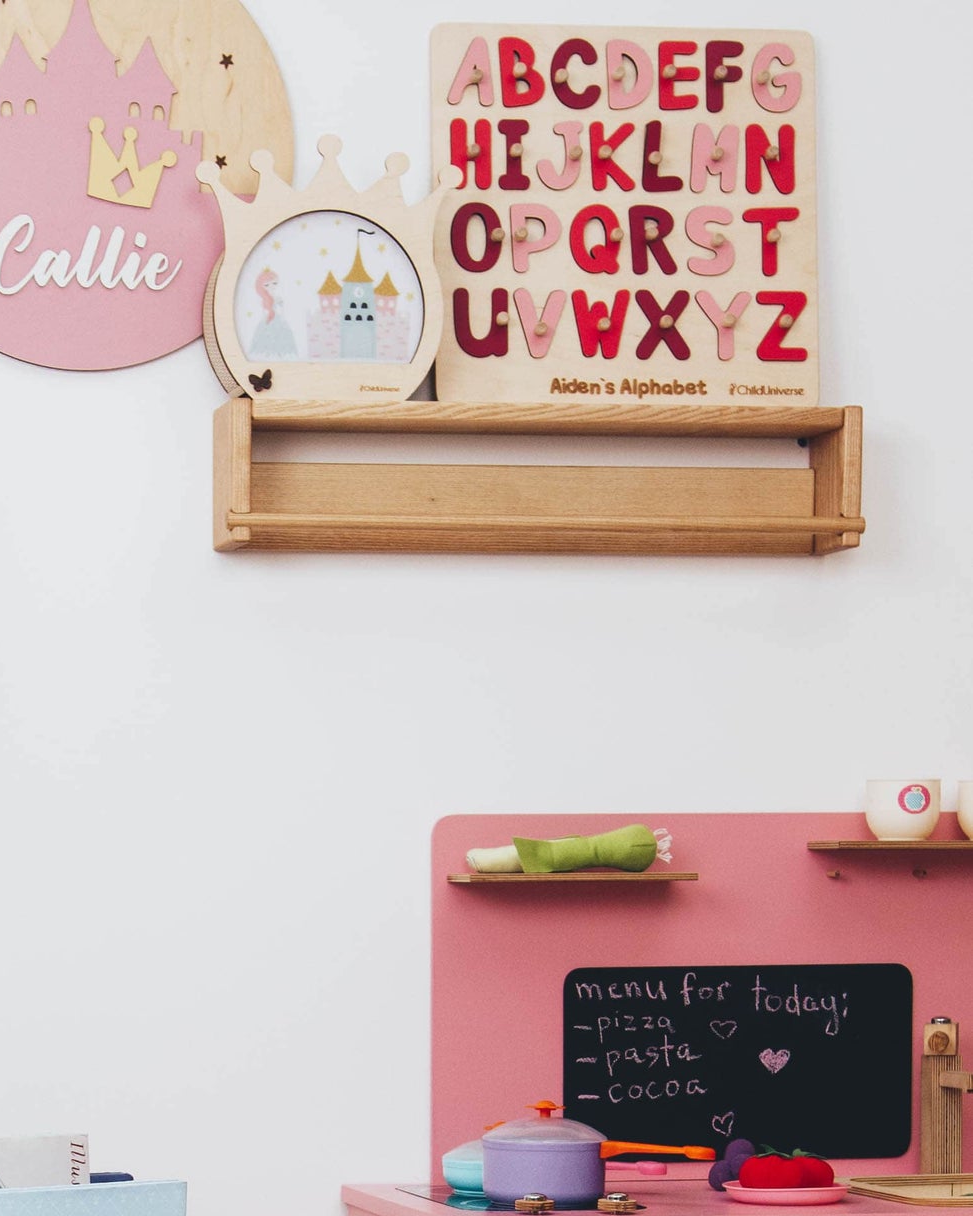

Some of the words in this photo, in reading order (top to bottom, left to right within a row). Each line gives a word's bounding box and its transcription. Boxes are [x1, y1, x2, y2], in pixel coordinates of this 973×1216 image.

[619, 378, 707, 399] Alphabet
[574, 977, 667, 1001] menu
[680, 972, 733, 1006] for
